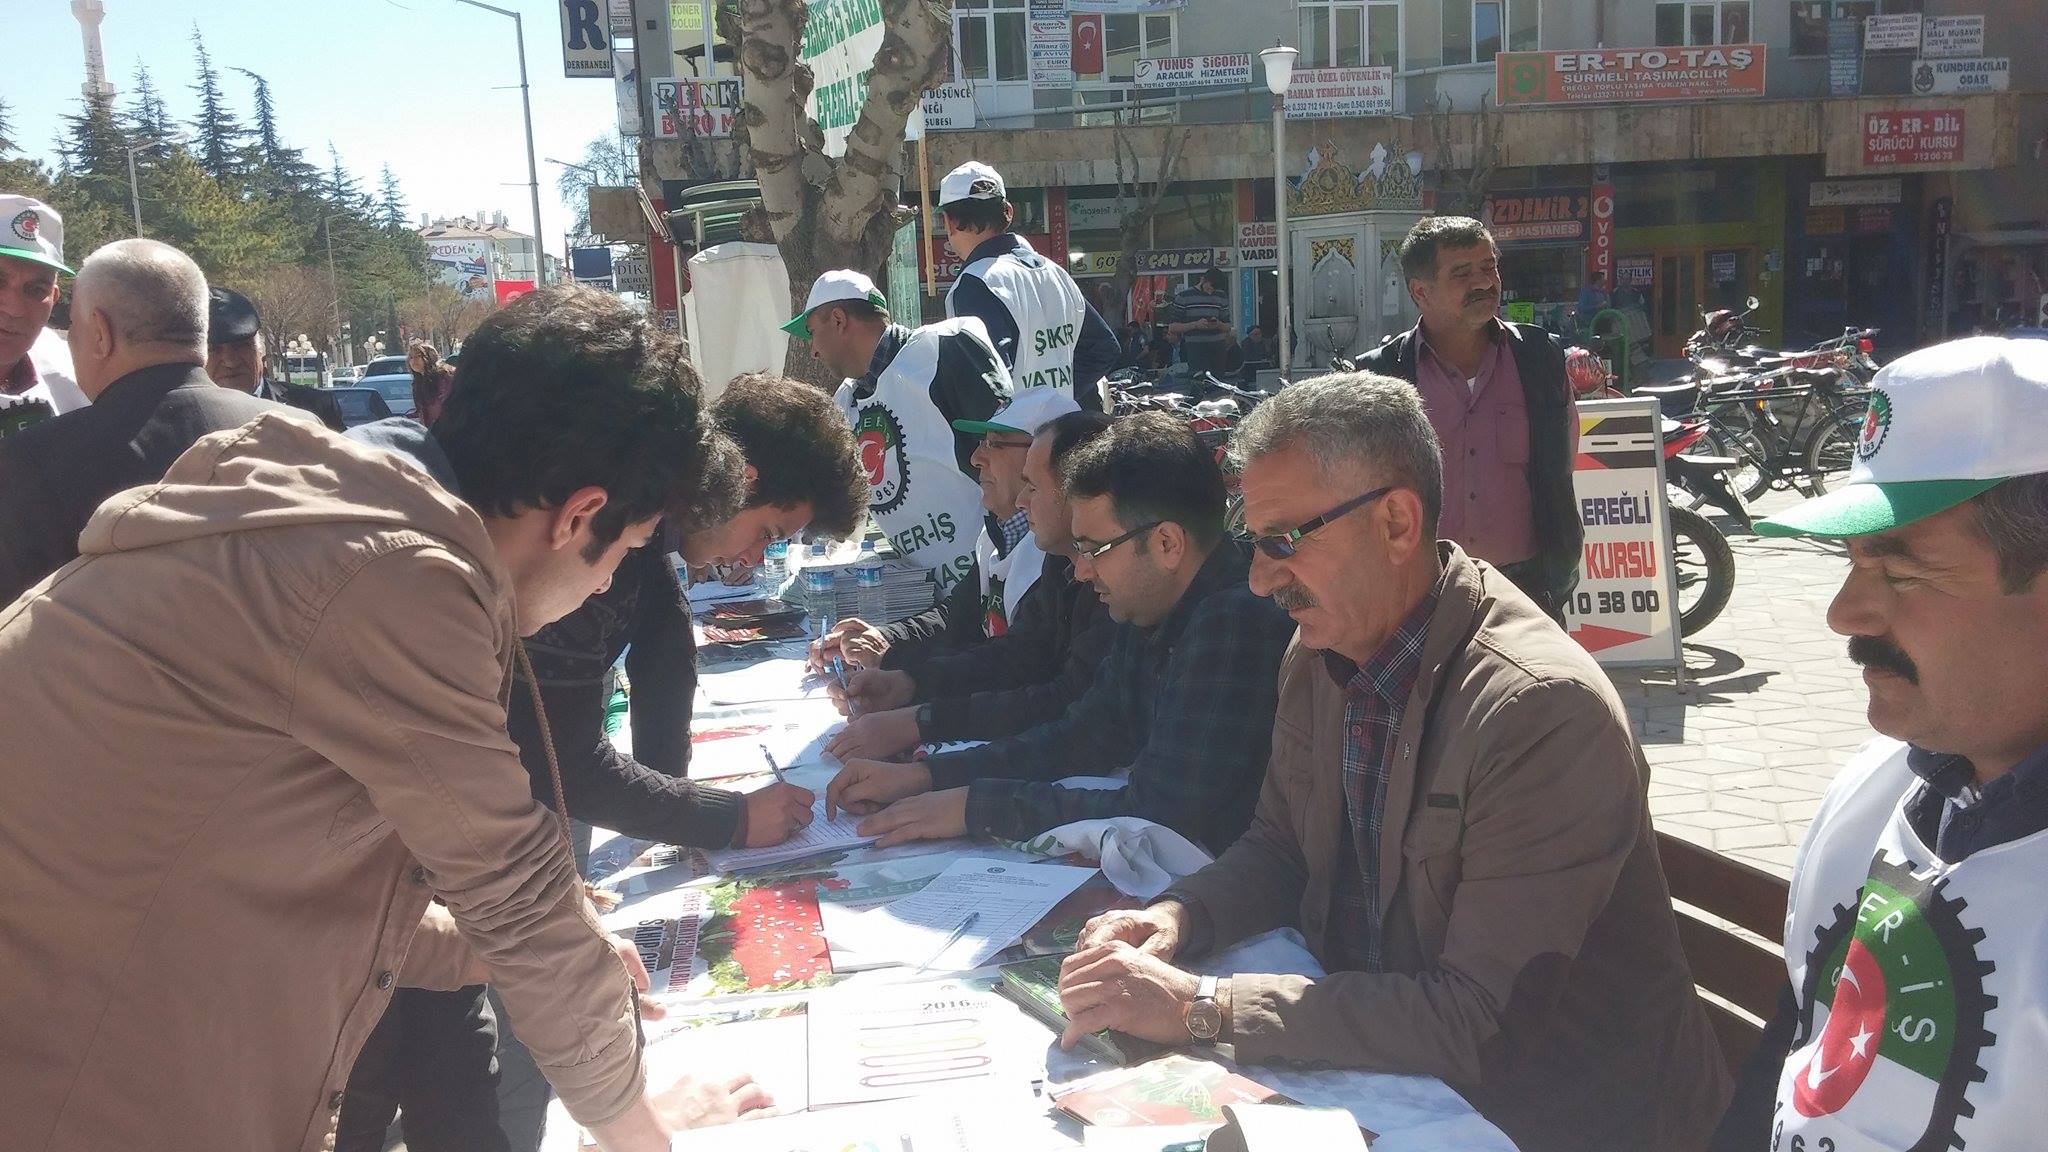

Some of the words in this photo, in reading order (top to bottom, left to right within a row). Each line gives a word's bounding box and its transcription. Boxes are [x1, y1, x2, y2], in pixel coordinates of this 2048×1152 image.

[672, 4, 700, 15] TONER
[672, 18, 700, 28] DOLUM
[567, 60, 610, 70] DERSHANESİ
[1157, 58, 1194, 70] YUNUS
[1203, 54, 1250, 68] SİGORTA
[1554, 48, 1753, 72] ER-TO-TAŞ
[1156, 71, 1193, 80] ARACILIK
[1201, 68, 1249, 78] HİZMETLERİ
[1317, 70, 1338, 82] ÖZEL
[1341, 68, 1381, 82] GÜVENLİK
[929, 87, 971, 101] DÜŞÜNCE
[1868, 135, 1914, 151] SÜRÜCÜ
[1920, 136, 1957, 150] KURSU
[1581, 490, 1652, 525] EREĞLİ
[1585, 541, 1657, 579] KURSU
[1598, 591, 1626, 614] 38
[1631, 590, 1660, 613] 00
[634, 918, 670, 948] SAHİP
